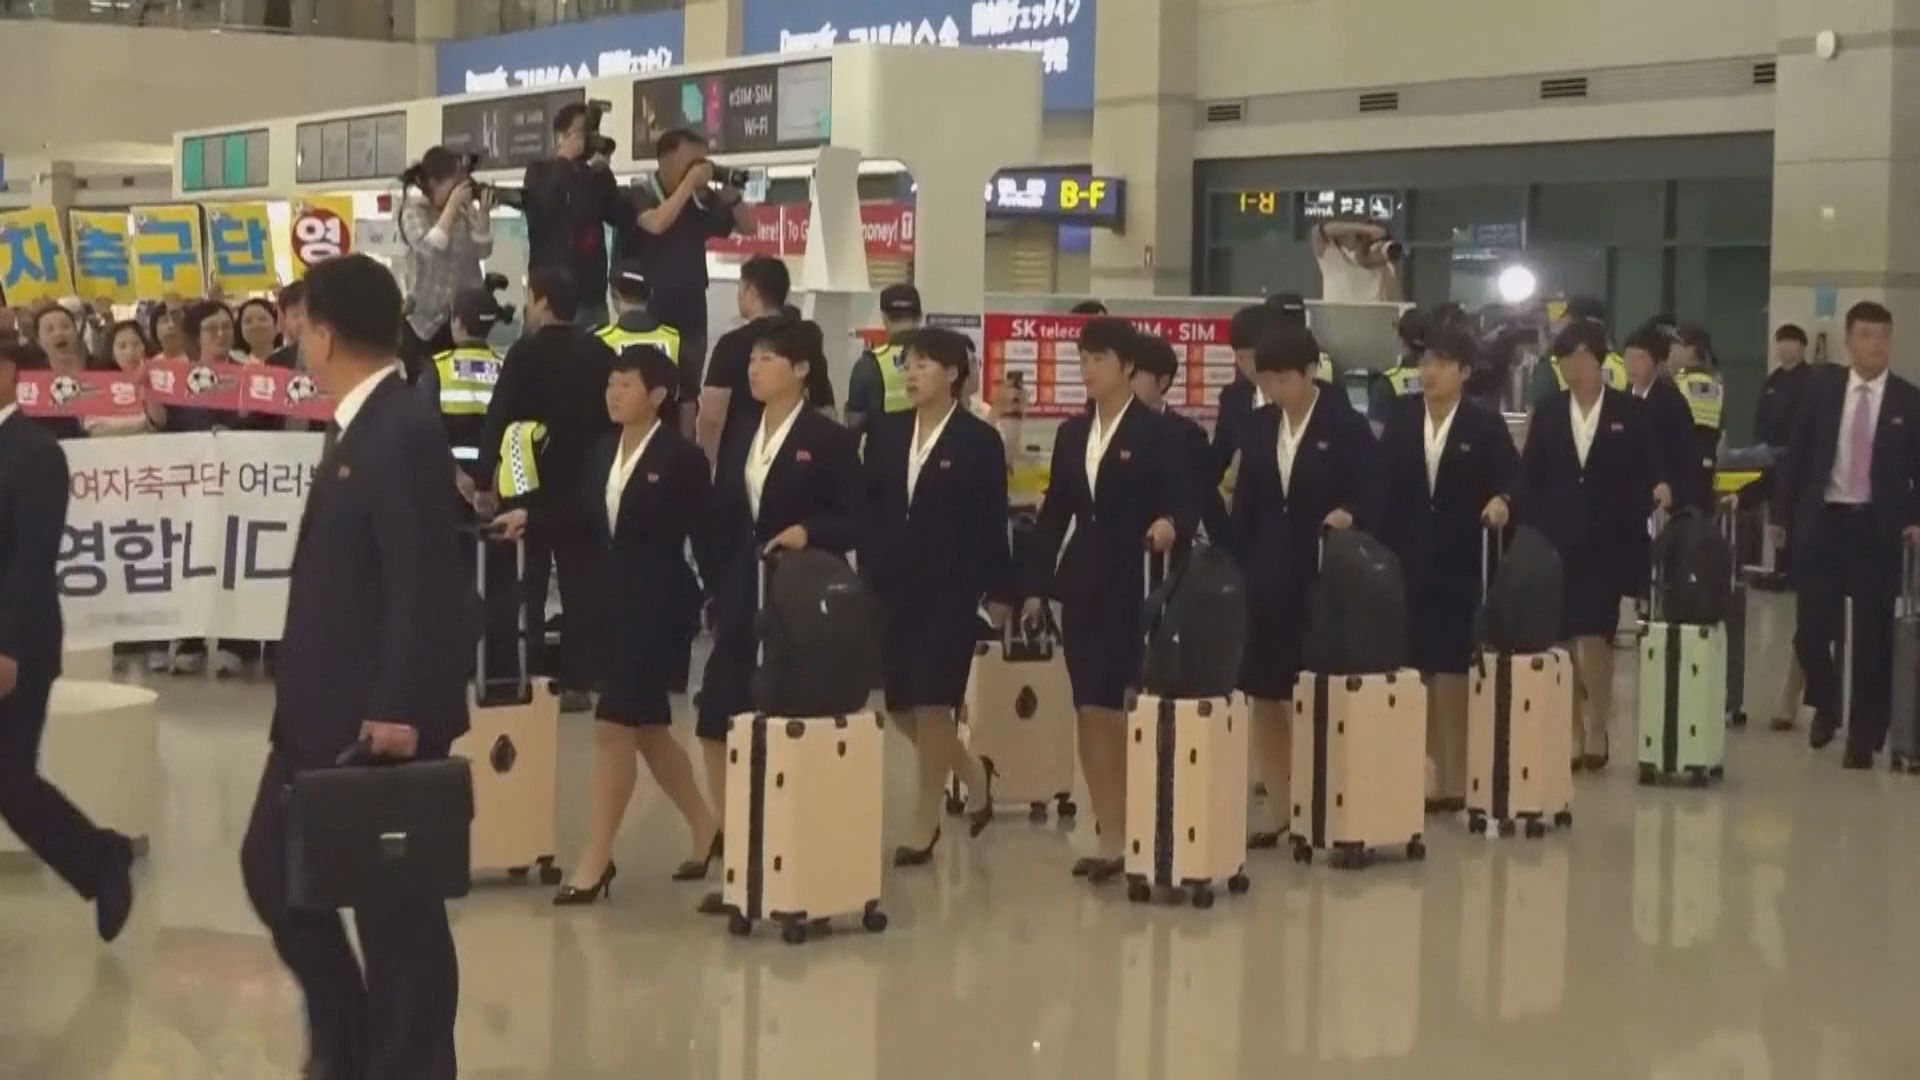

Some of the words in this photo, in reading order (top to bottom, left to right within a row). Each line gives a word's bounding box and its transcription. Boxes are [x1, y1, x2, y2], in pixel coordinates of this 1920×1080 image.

[744, 116, 768, 136] Wi-Fi
[1060, 179, 1106, 208] B-F
[296, 215, 342, 264] 영
[787, 220, 799, 241] To
[0, 222, 59, 288] 자
[78, 227, 129, 287] 축
[138, 220, 197, 281] 구
[212, 216, 267, 276] 단
[1011, 318, 1038, 338] SK
[1040, 321, 1083, 339] telec
[1179, 321, 1216, 341] SIM
[70, 460, 229, 502] 여자축구단
